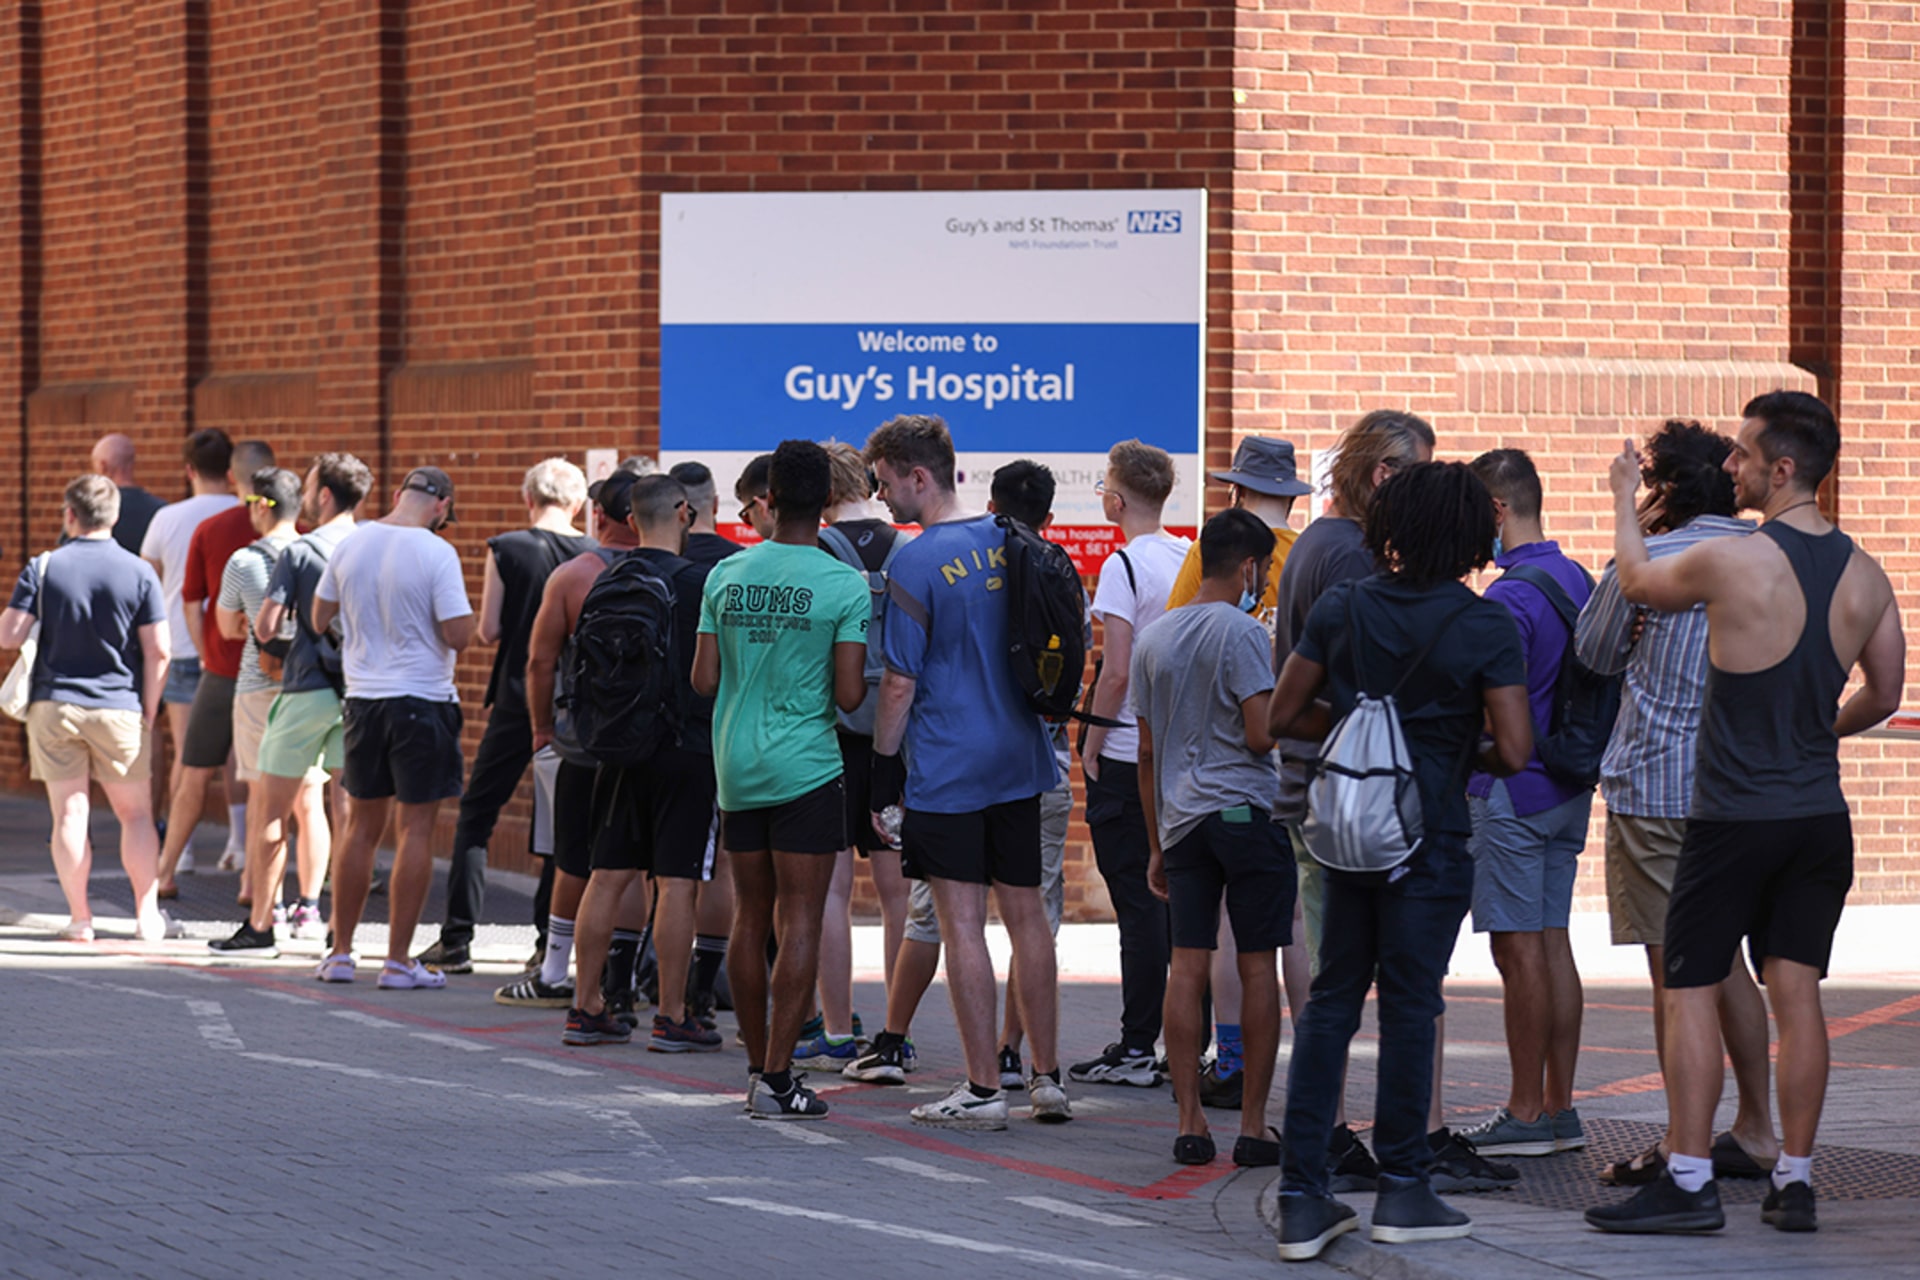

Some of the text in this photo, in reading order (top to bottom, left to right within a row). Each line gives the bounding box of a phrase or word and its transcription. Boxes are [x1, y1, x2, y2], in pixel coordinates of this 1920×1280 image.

[945, 217, 988, 236] Guy's
[993, 217, 1025, 233] and
[1029, 217, 1046, 233] St
[1129, 211, 1180, 233] NHS
[1032, 239, 1090, 250] Foundation
[1092, 239, 1119, 250] Trust
[857, 329, 999, 353] Welcome to
[784, 363, 1075, 410] Guy's Hospital
[1053, 470, 1092, 485] ALTH
[1069, 527, 1115, 542] hospital
[940, 545, 1008, 586] NIK
[725, 584, 813, 615] RUMS
